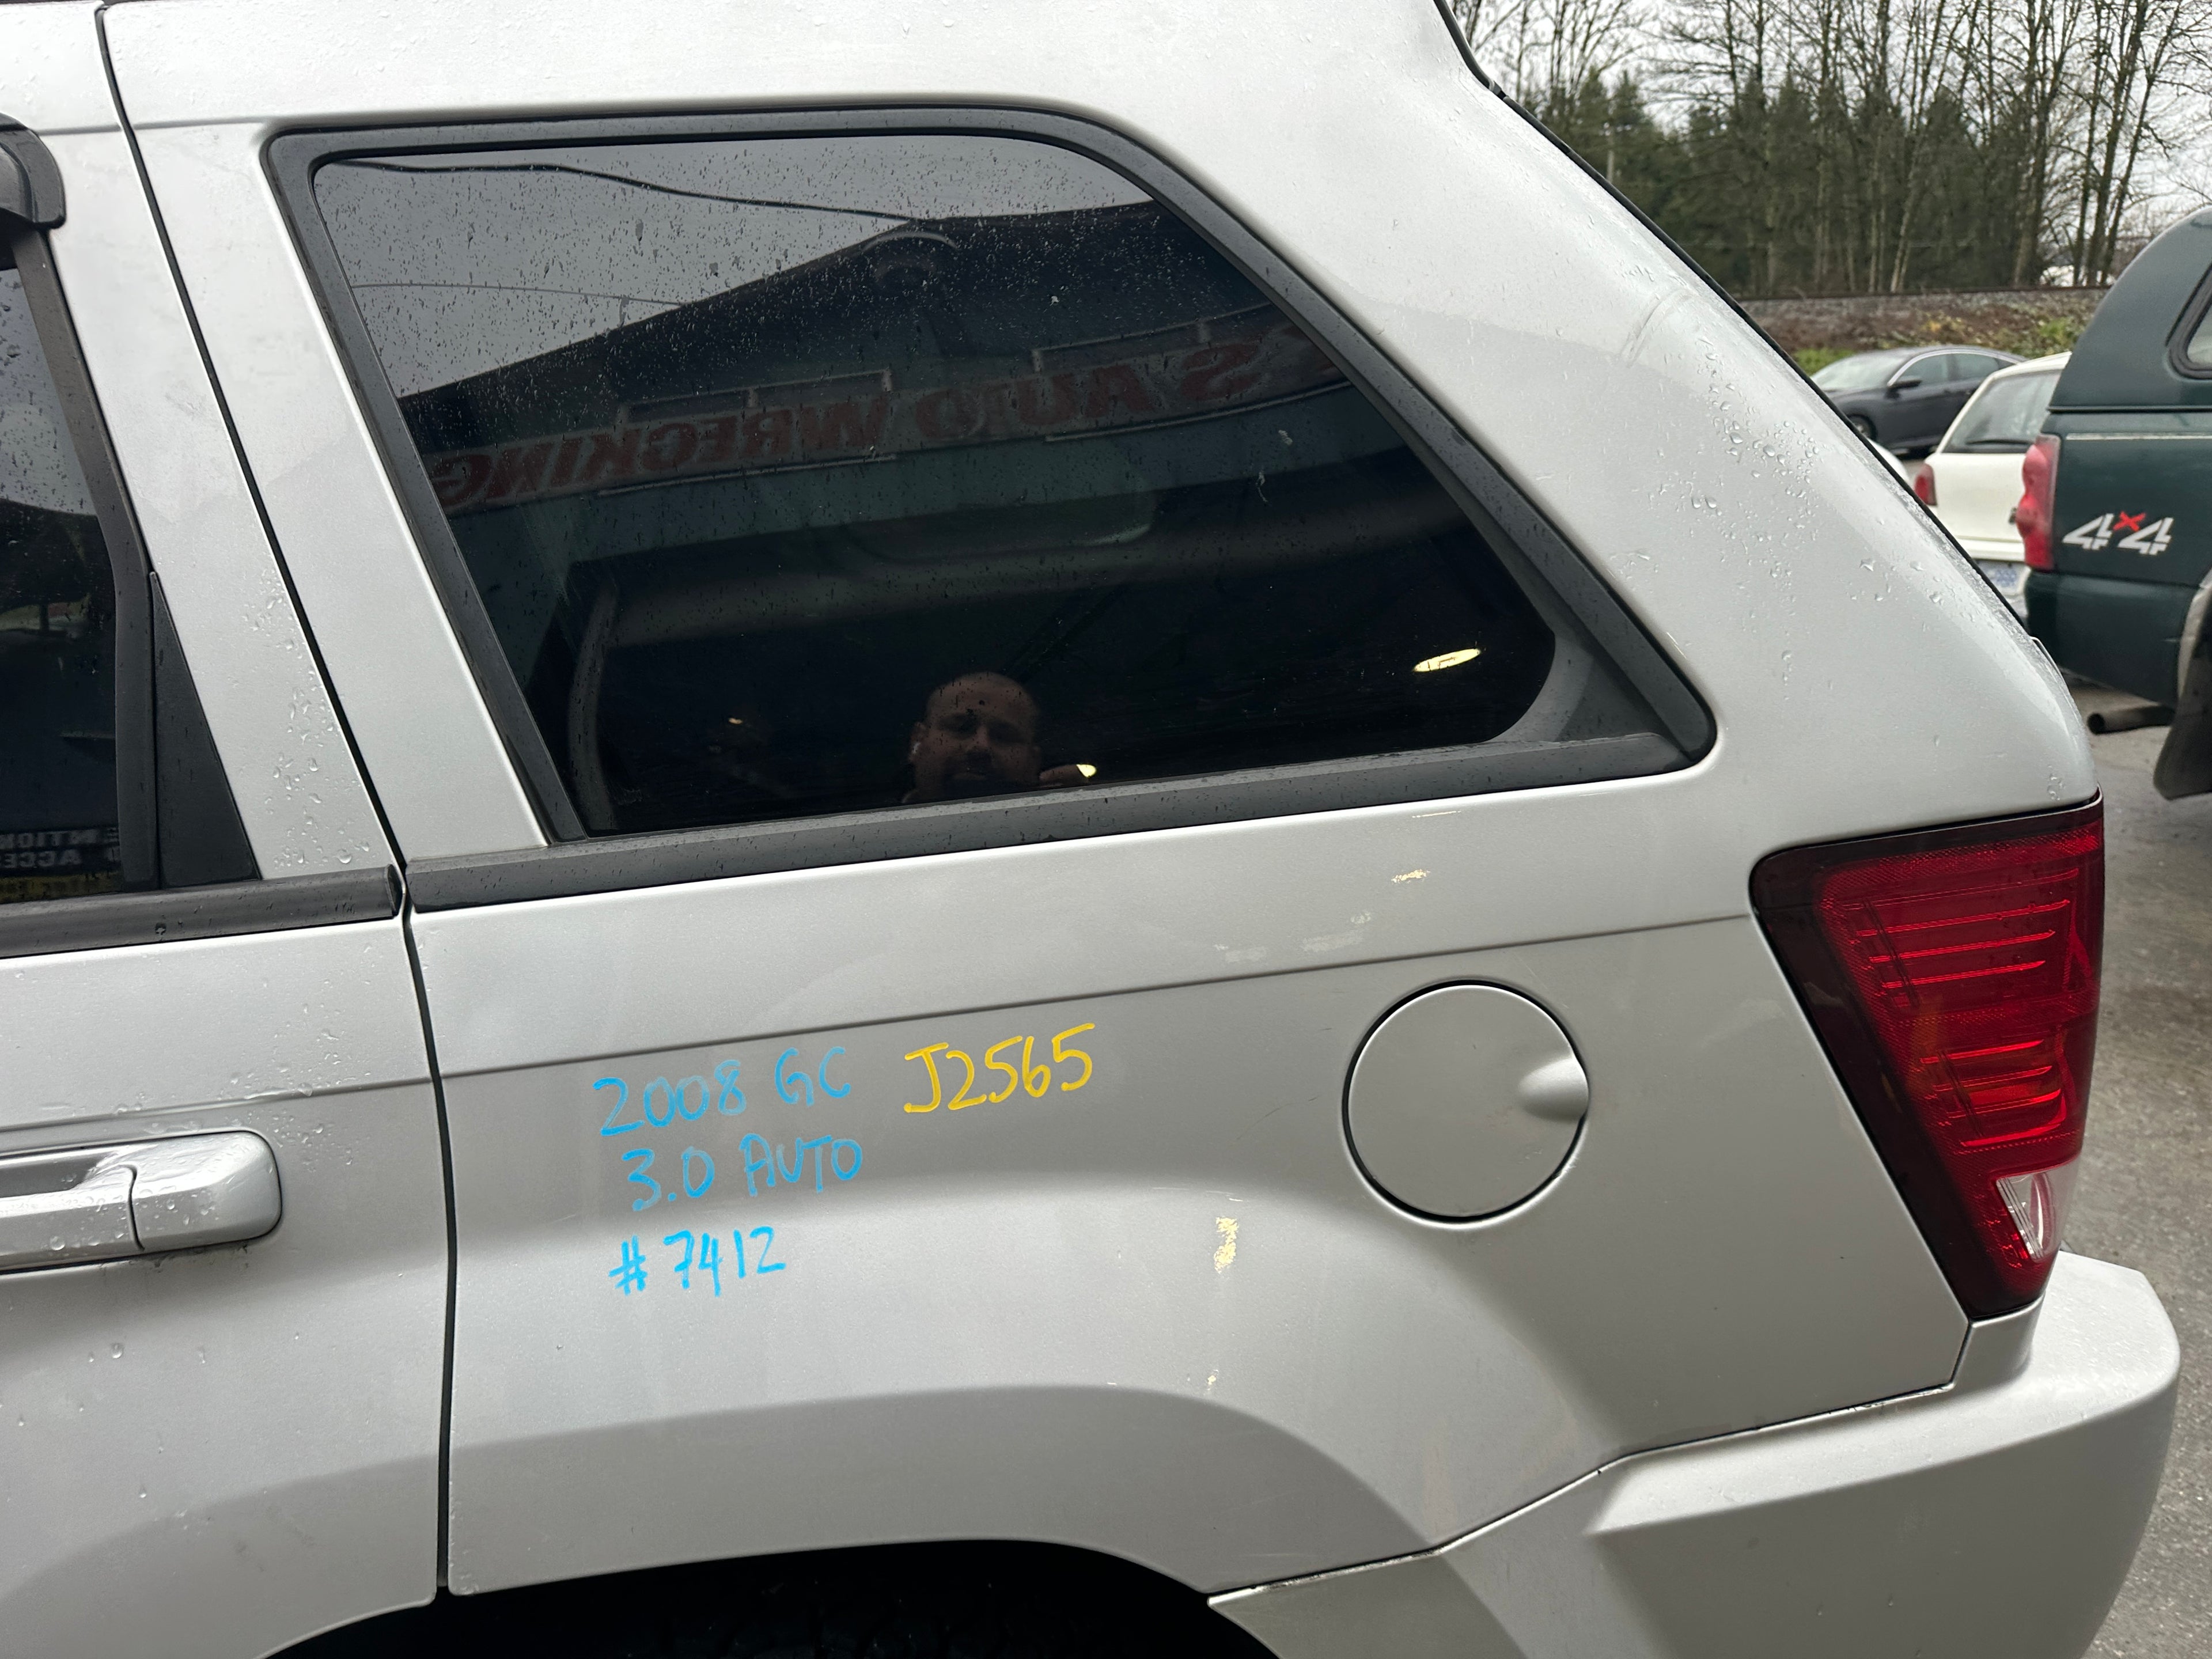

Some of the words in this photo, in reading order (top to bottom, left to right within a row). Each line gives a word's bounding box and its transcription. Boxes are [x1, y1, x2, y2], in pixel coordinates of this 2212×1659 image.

[592, 1060, 748, 1138] 2008
[775, 1047, 851, 1107] GC
[903, 1023, 1095, 1113] J2565
[621, 1147, 715, 1211] 3.0
[738, 1133, 863, 1196] AUTO
